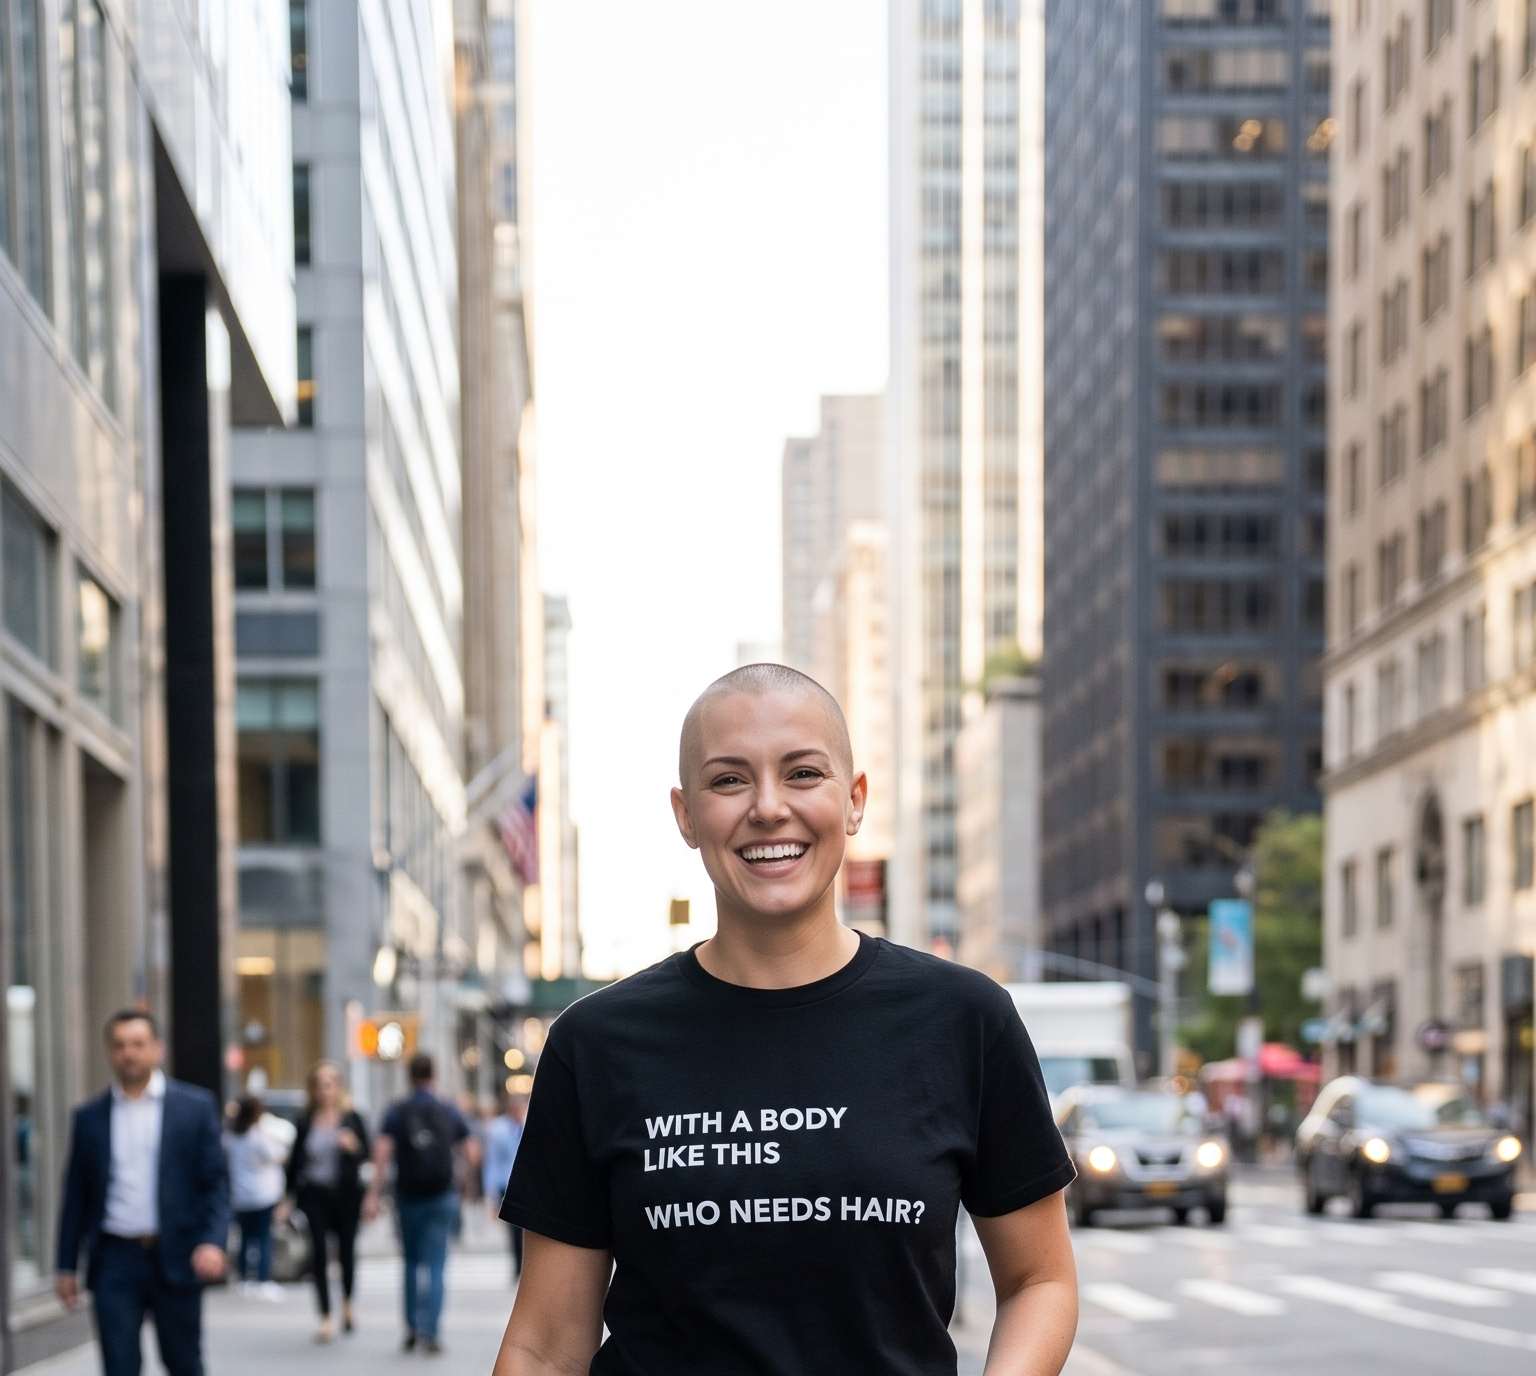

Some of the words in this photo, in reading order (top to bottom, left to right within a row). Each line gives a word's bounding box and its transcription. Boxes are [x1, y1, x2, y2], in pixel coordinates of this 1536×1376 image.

[644, 1112, 722, 1139] WITH
[730, 1110, 753, 1132] A
[760, 1106, 848, 1131] BODY
[644, 1145, 705, 1172] LIKE
[711, 1141, 781, 1165] THIS
[645, 1200, 721, 1230] WHO
[729, 1196, 831, 1224] NEEDS
[840, 1196, 926, 1225] HAIR?
